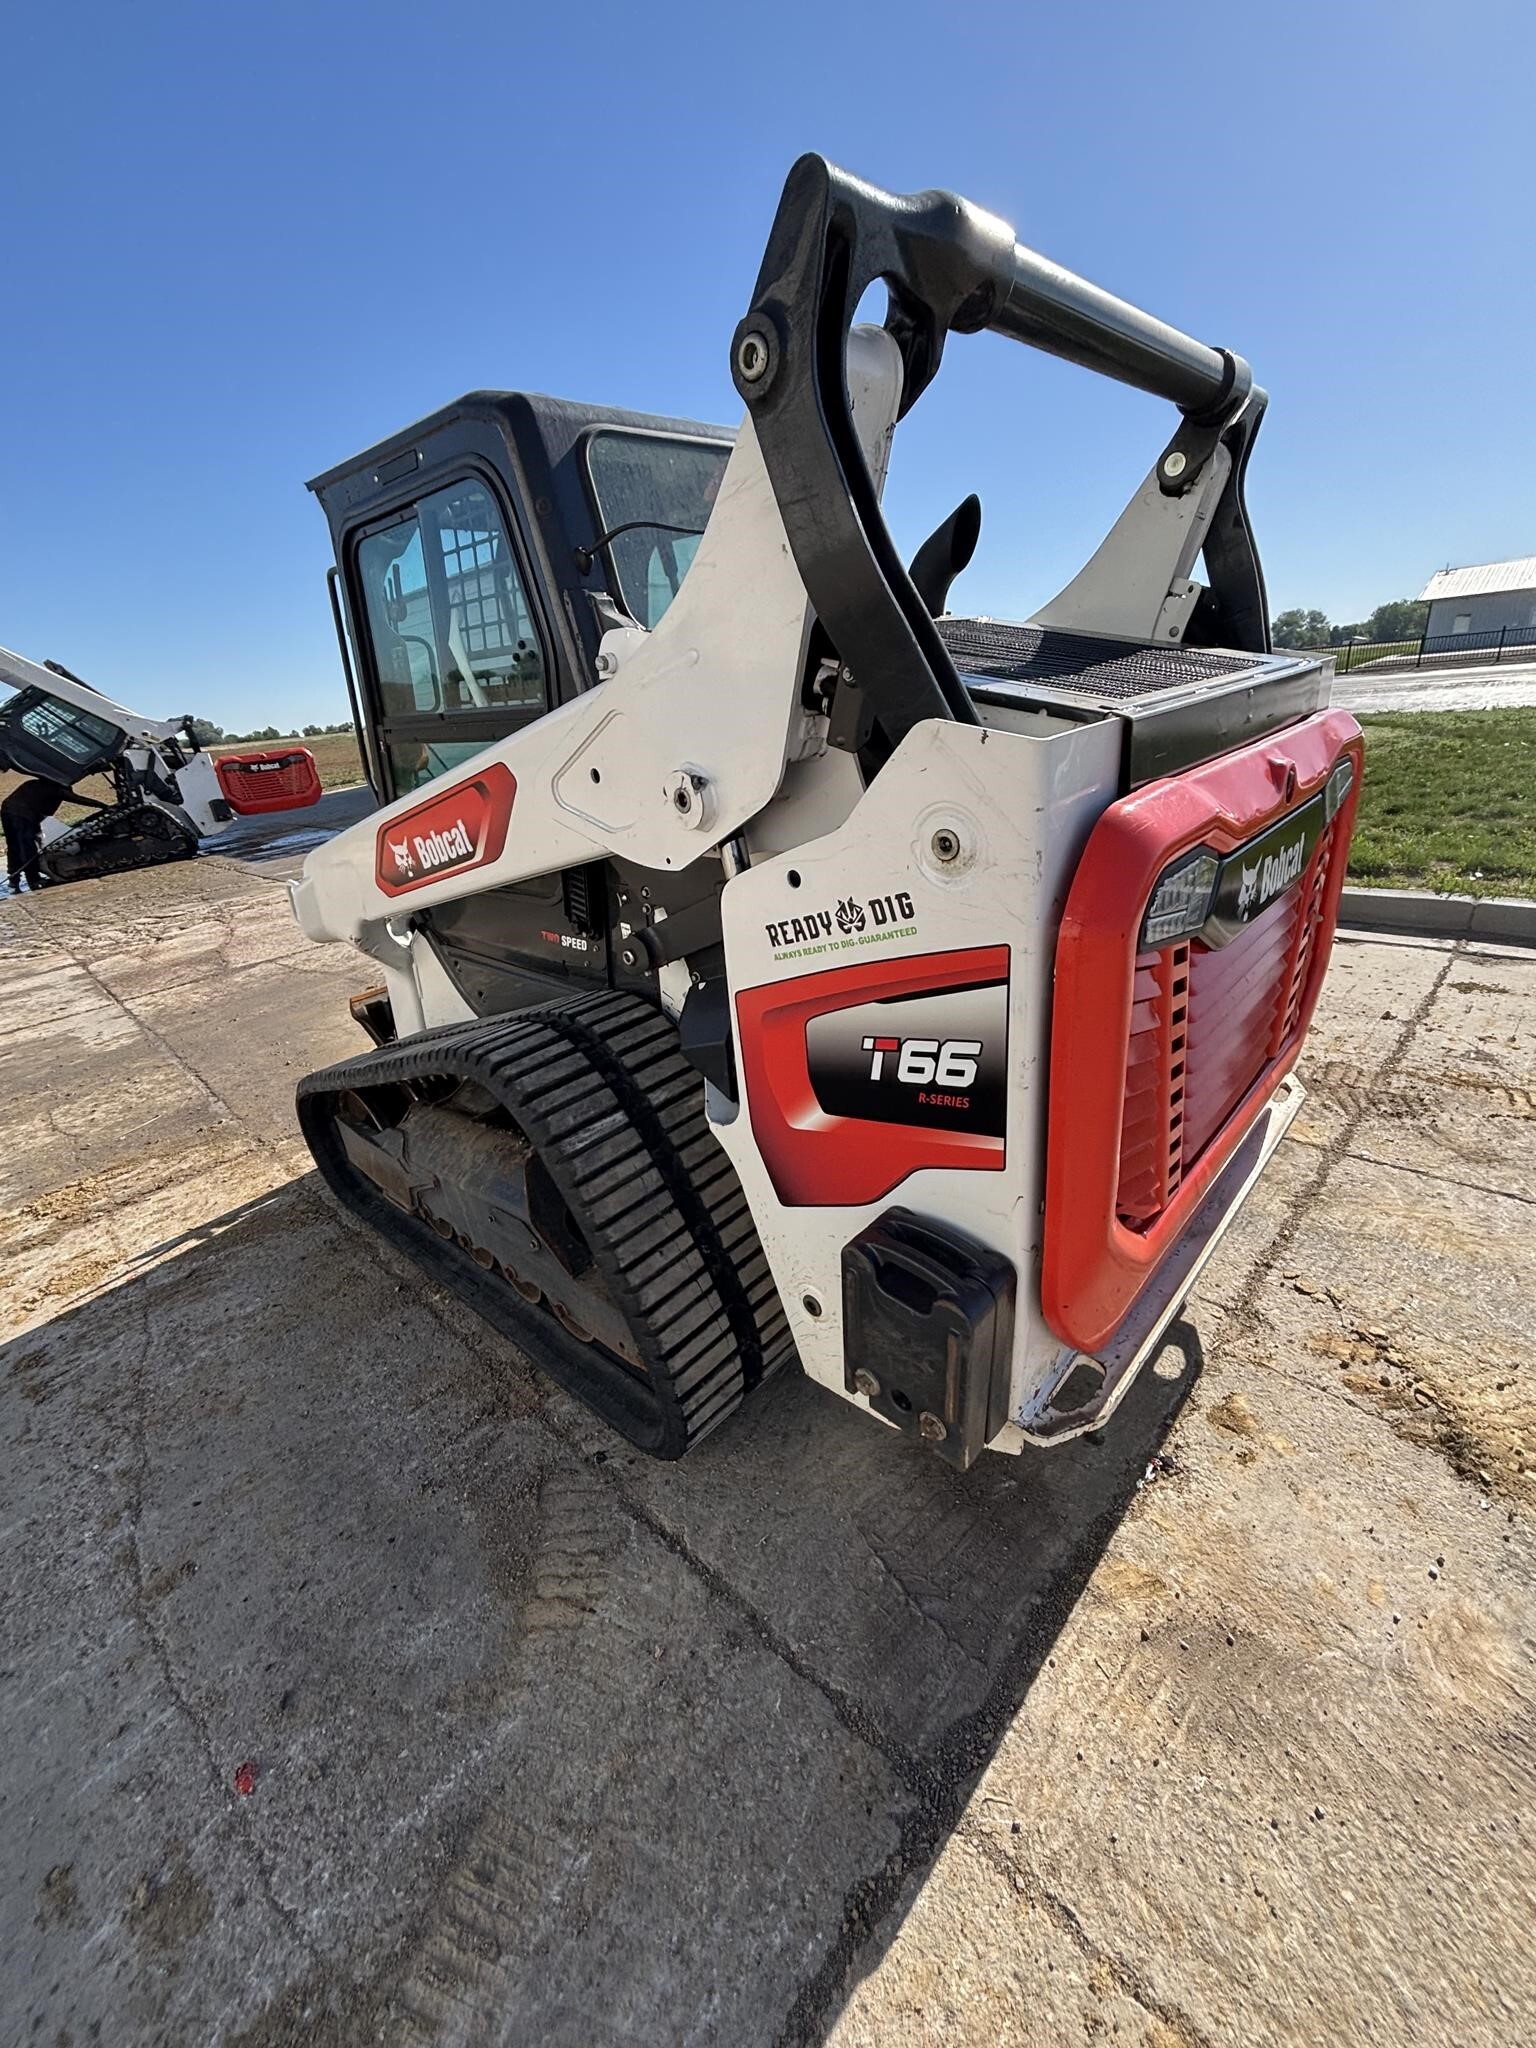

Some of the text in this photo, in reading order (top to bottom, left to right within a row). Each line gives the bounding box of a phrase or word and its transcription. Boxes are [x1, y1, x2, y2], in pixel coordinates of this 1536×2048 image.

[414, 819, 473, 869] Bobcat
[1260, 832, 1305, 904] Bobcat
[561, 935, 588, 951] SPEED
[765, 892, 915, 948] READY DIG
[774, 949, 803, 961] ALWAYS
[803, 945, 827, 957] READY
[828, 941, 840, 952] TO
[858, 927, 917, 945] GUARANTEED
[861, 1035, 984, 1088] T66
[918, 1092, 970, 1108] R-SERIES
